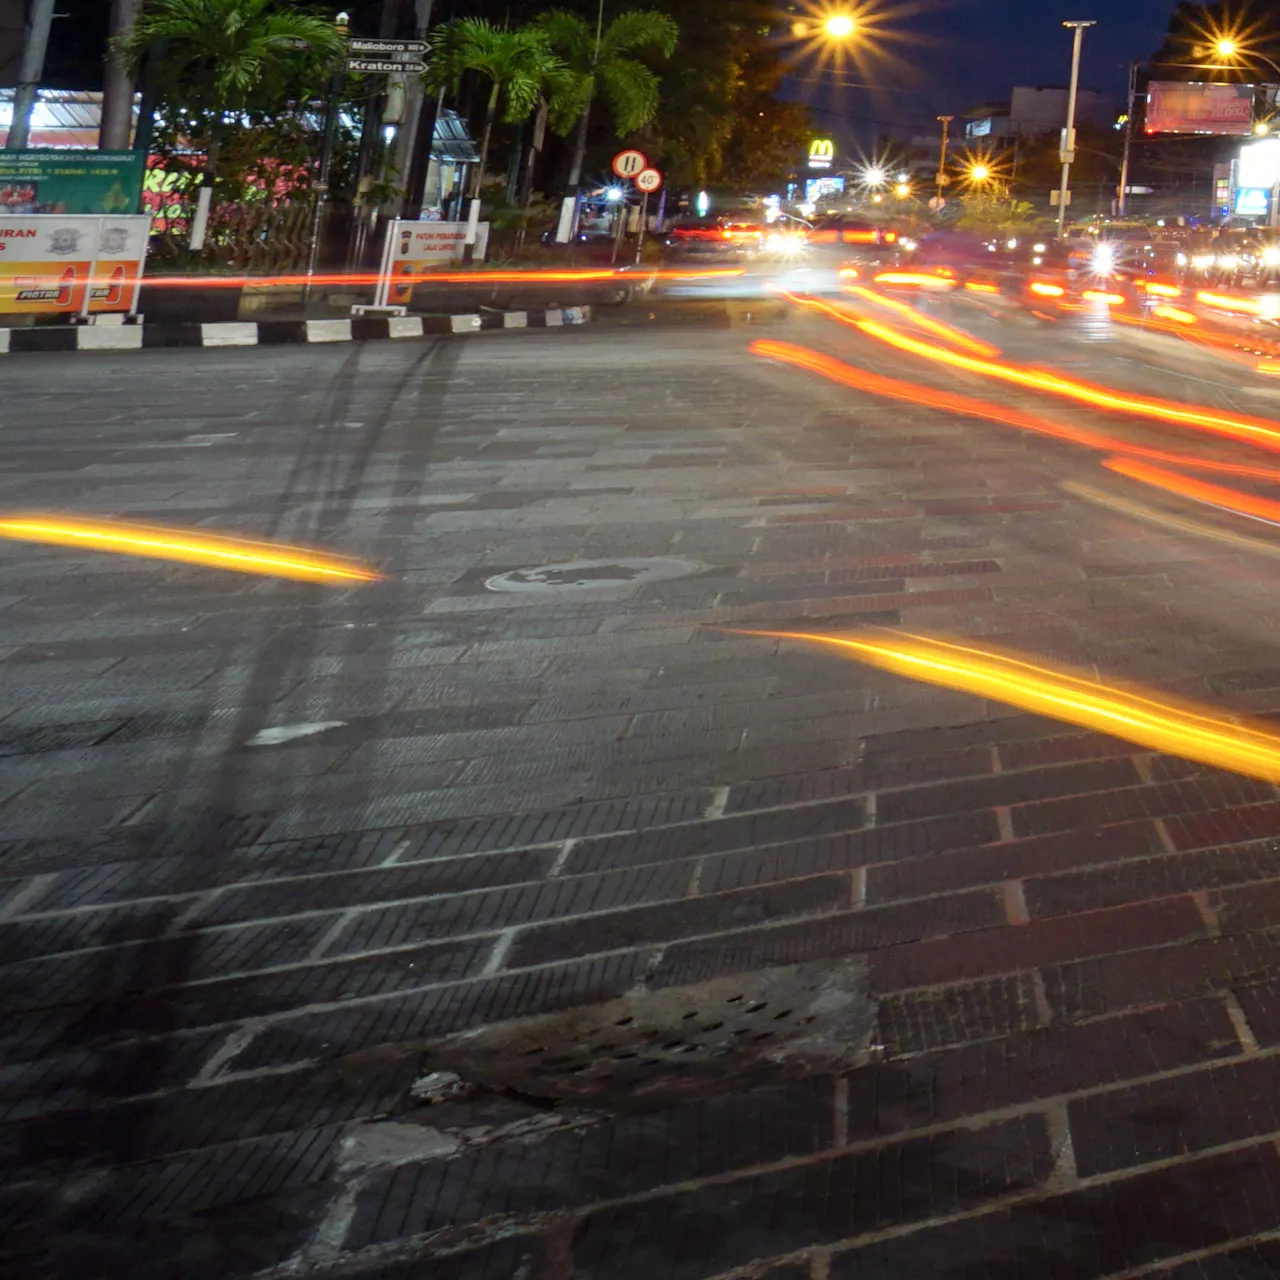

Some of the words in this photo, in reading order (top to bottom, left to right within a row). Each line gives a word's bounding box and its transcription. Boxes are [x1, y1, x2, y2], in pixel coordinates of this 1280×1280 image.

[352, 41, 405, 51] Malioboro
[349, 61, 402, 71] Kraton
[640, 175, 654, 185] 40
